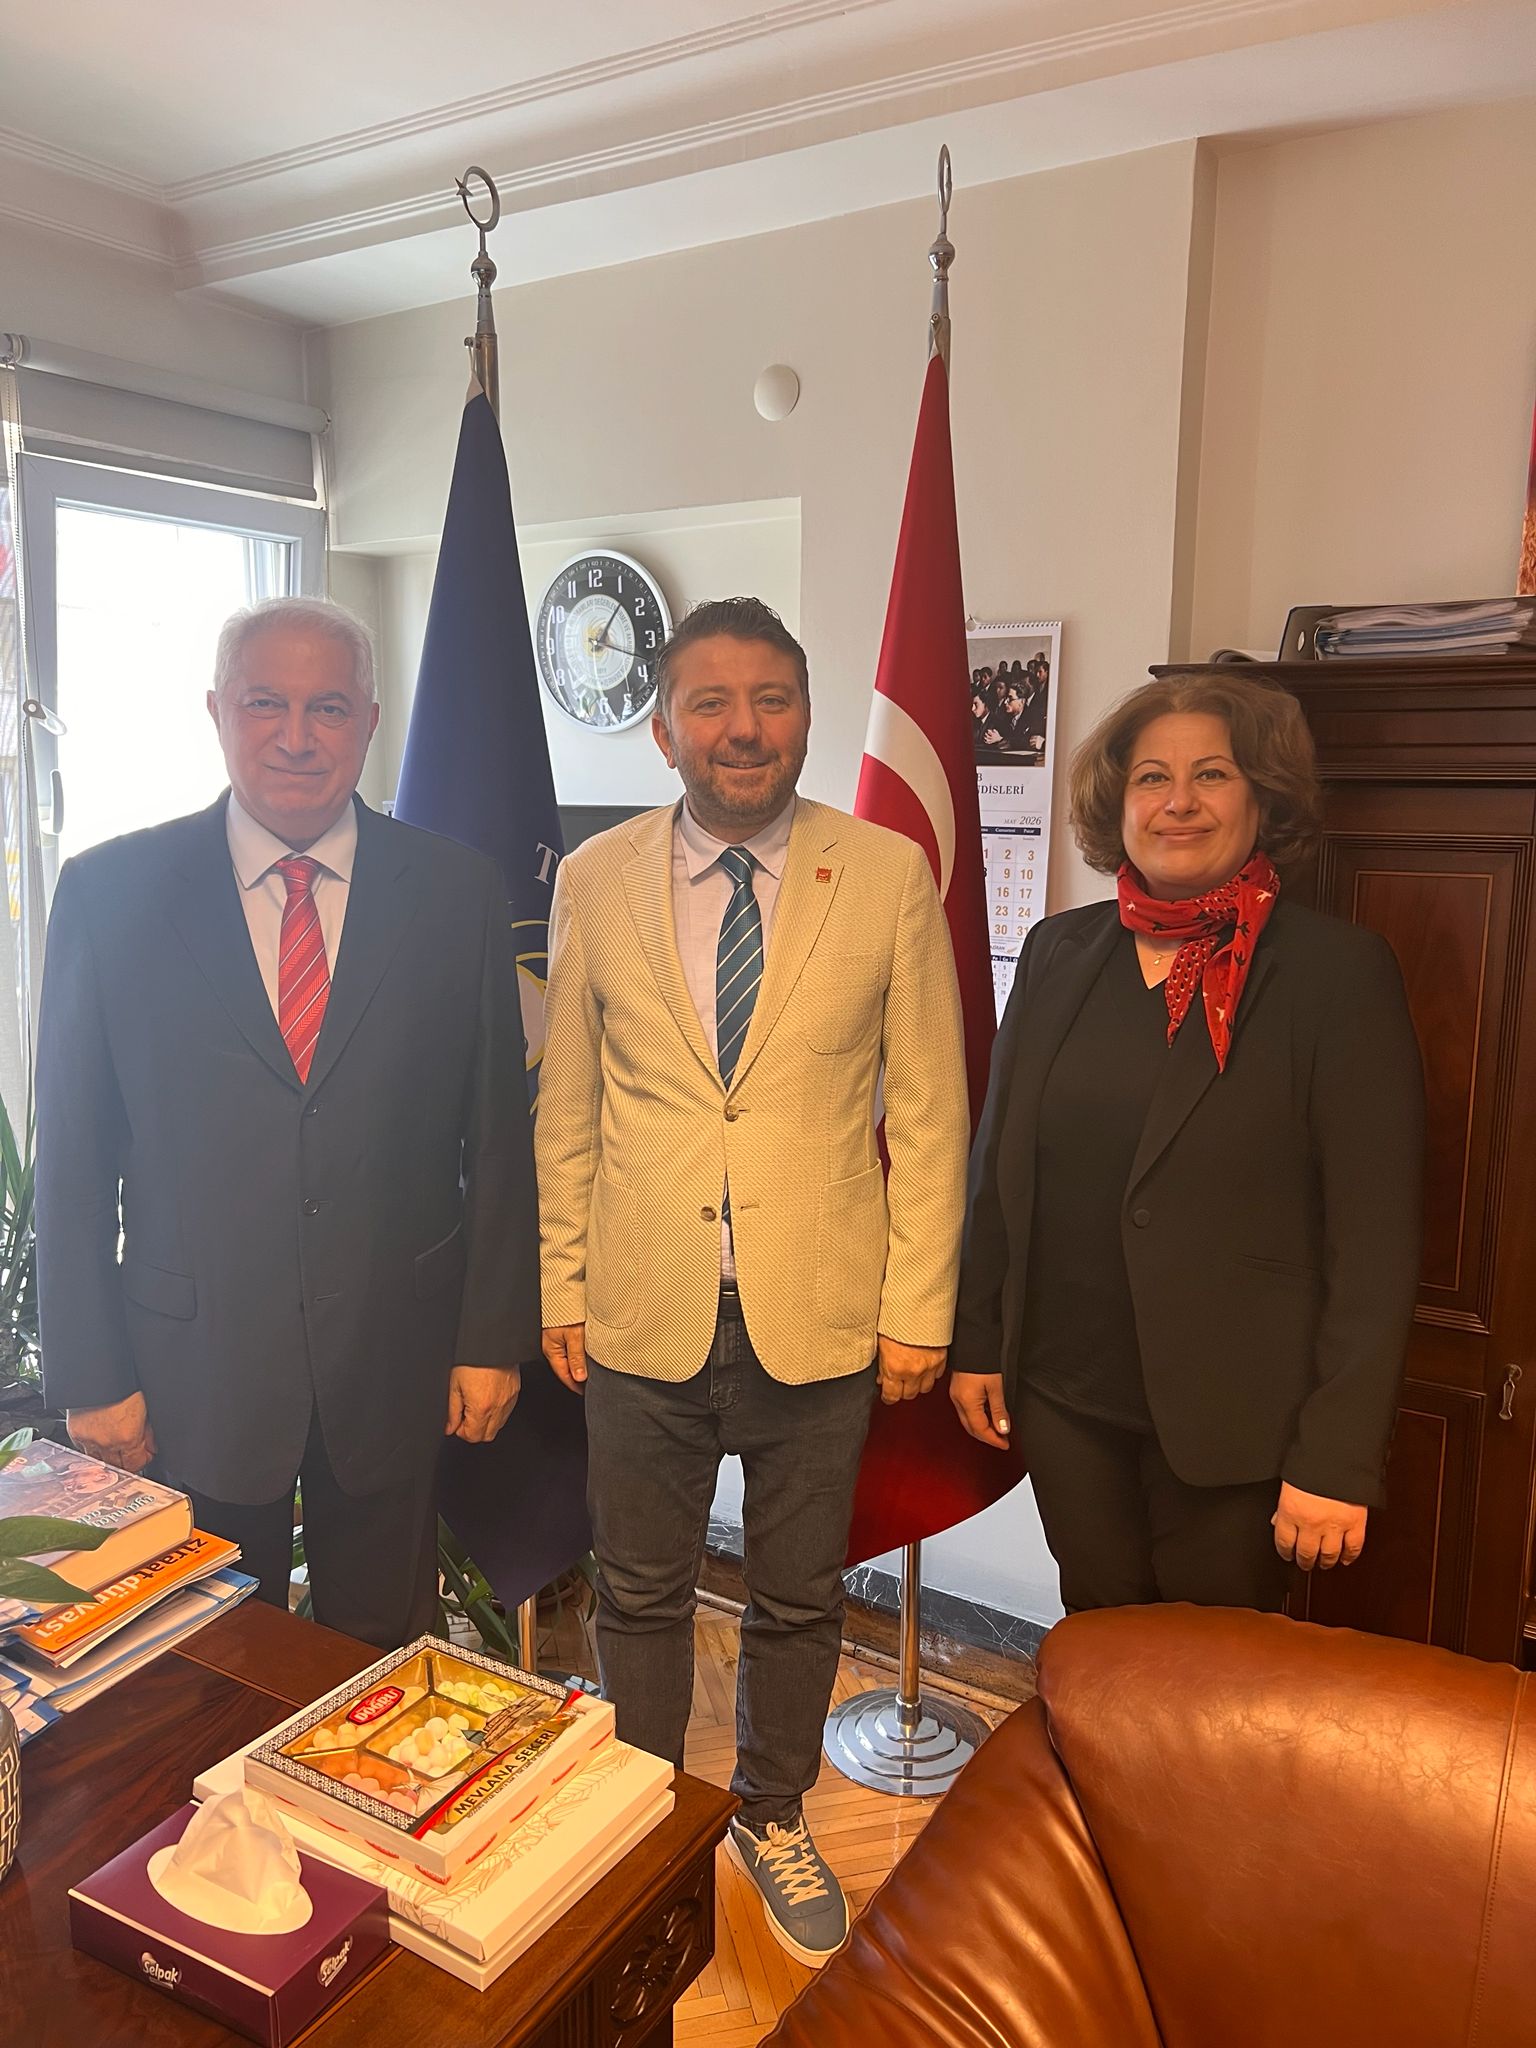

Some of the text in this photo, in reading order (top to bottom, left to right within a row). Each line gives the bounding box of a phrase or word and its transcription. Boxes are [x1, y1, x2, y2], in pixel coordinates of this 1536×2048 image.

[588, 569, 603, 588] 12
[617, 575, 622, 594] 1
[568, 580, 577, 599] 11
[551, 605, 565, 624] 10
[635, 598, 645, 616] 2
[546, 637, 555, 656] 9
[645, 630, 655, 649] 3
[556, 668, 565, 687] 8
[638, 664, 648, 683] 4
[600, 697, 609, 715] 6
[624, 693, 632, 711] 5
[979, 784, 1025, 795] DİSLERİ
[1019, 815, 1042, 826] 2026
[534, 842, 559, 885] T
[983, 848, 1035, 861] 1 2 3
[1003, 868, 1011, 879] 9
[1020, 869, 1034, 880] 10
[996, 887, 1033, 899] 16 17
[995, 905, 1031, 918] 23 24
[994, 924, 1028, 936] 30 31
[354, 1690, 398, 1721] DOĞRU
[454, 1764, 518, 1815] MEVLANA
[320, 1940, 350, 1981] Selpak
[143, 1960, 180, 1983] Selpak
